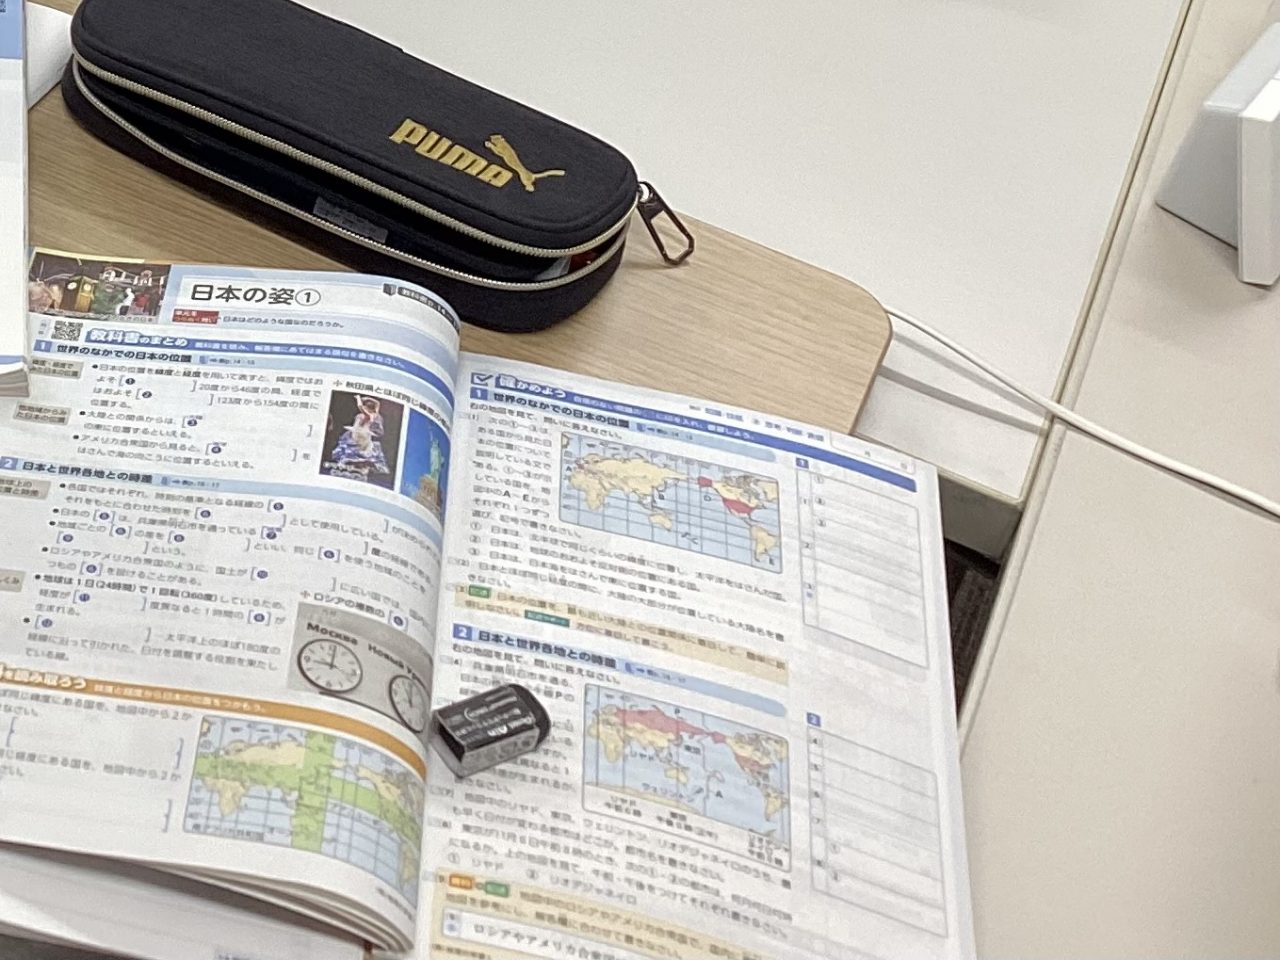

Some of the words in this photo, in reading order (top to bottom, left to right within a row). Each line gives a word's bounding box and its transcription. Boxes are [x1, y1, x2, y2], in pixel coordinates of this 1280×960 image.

[389, 118, 513, 188] PUMA
[90, 329, 188, 347] 教科書のまとめ
[57, 344, 192, 363] 世界のなかでの日本の位置
[493, 391, 630, 430] 世界のなかでの日本の位置
[22, 459, 153, 485] 日本と世界各地との時差
